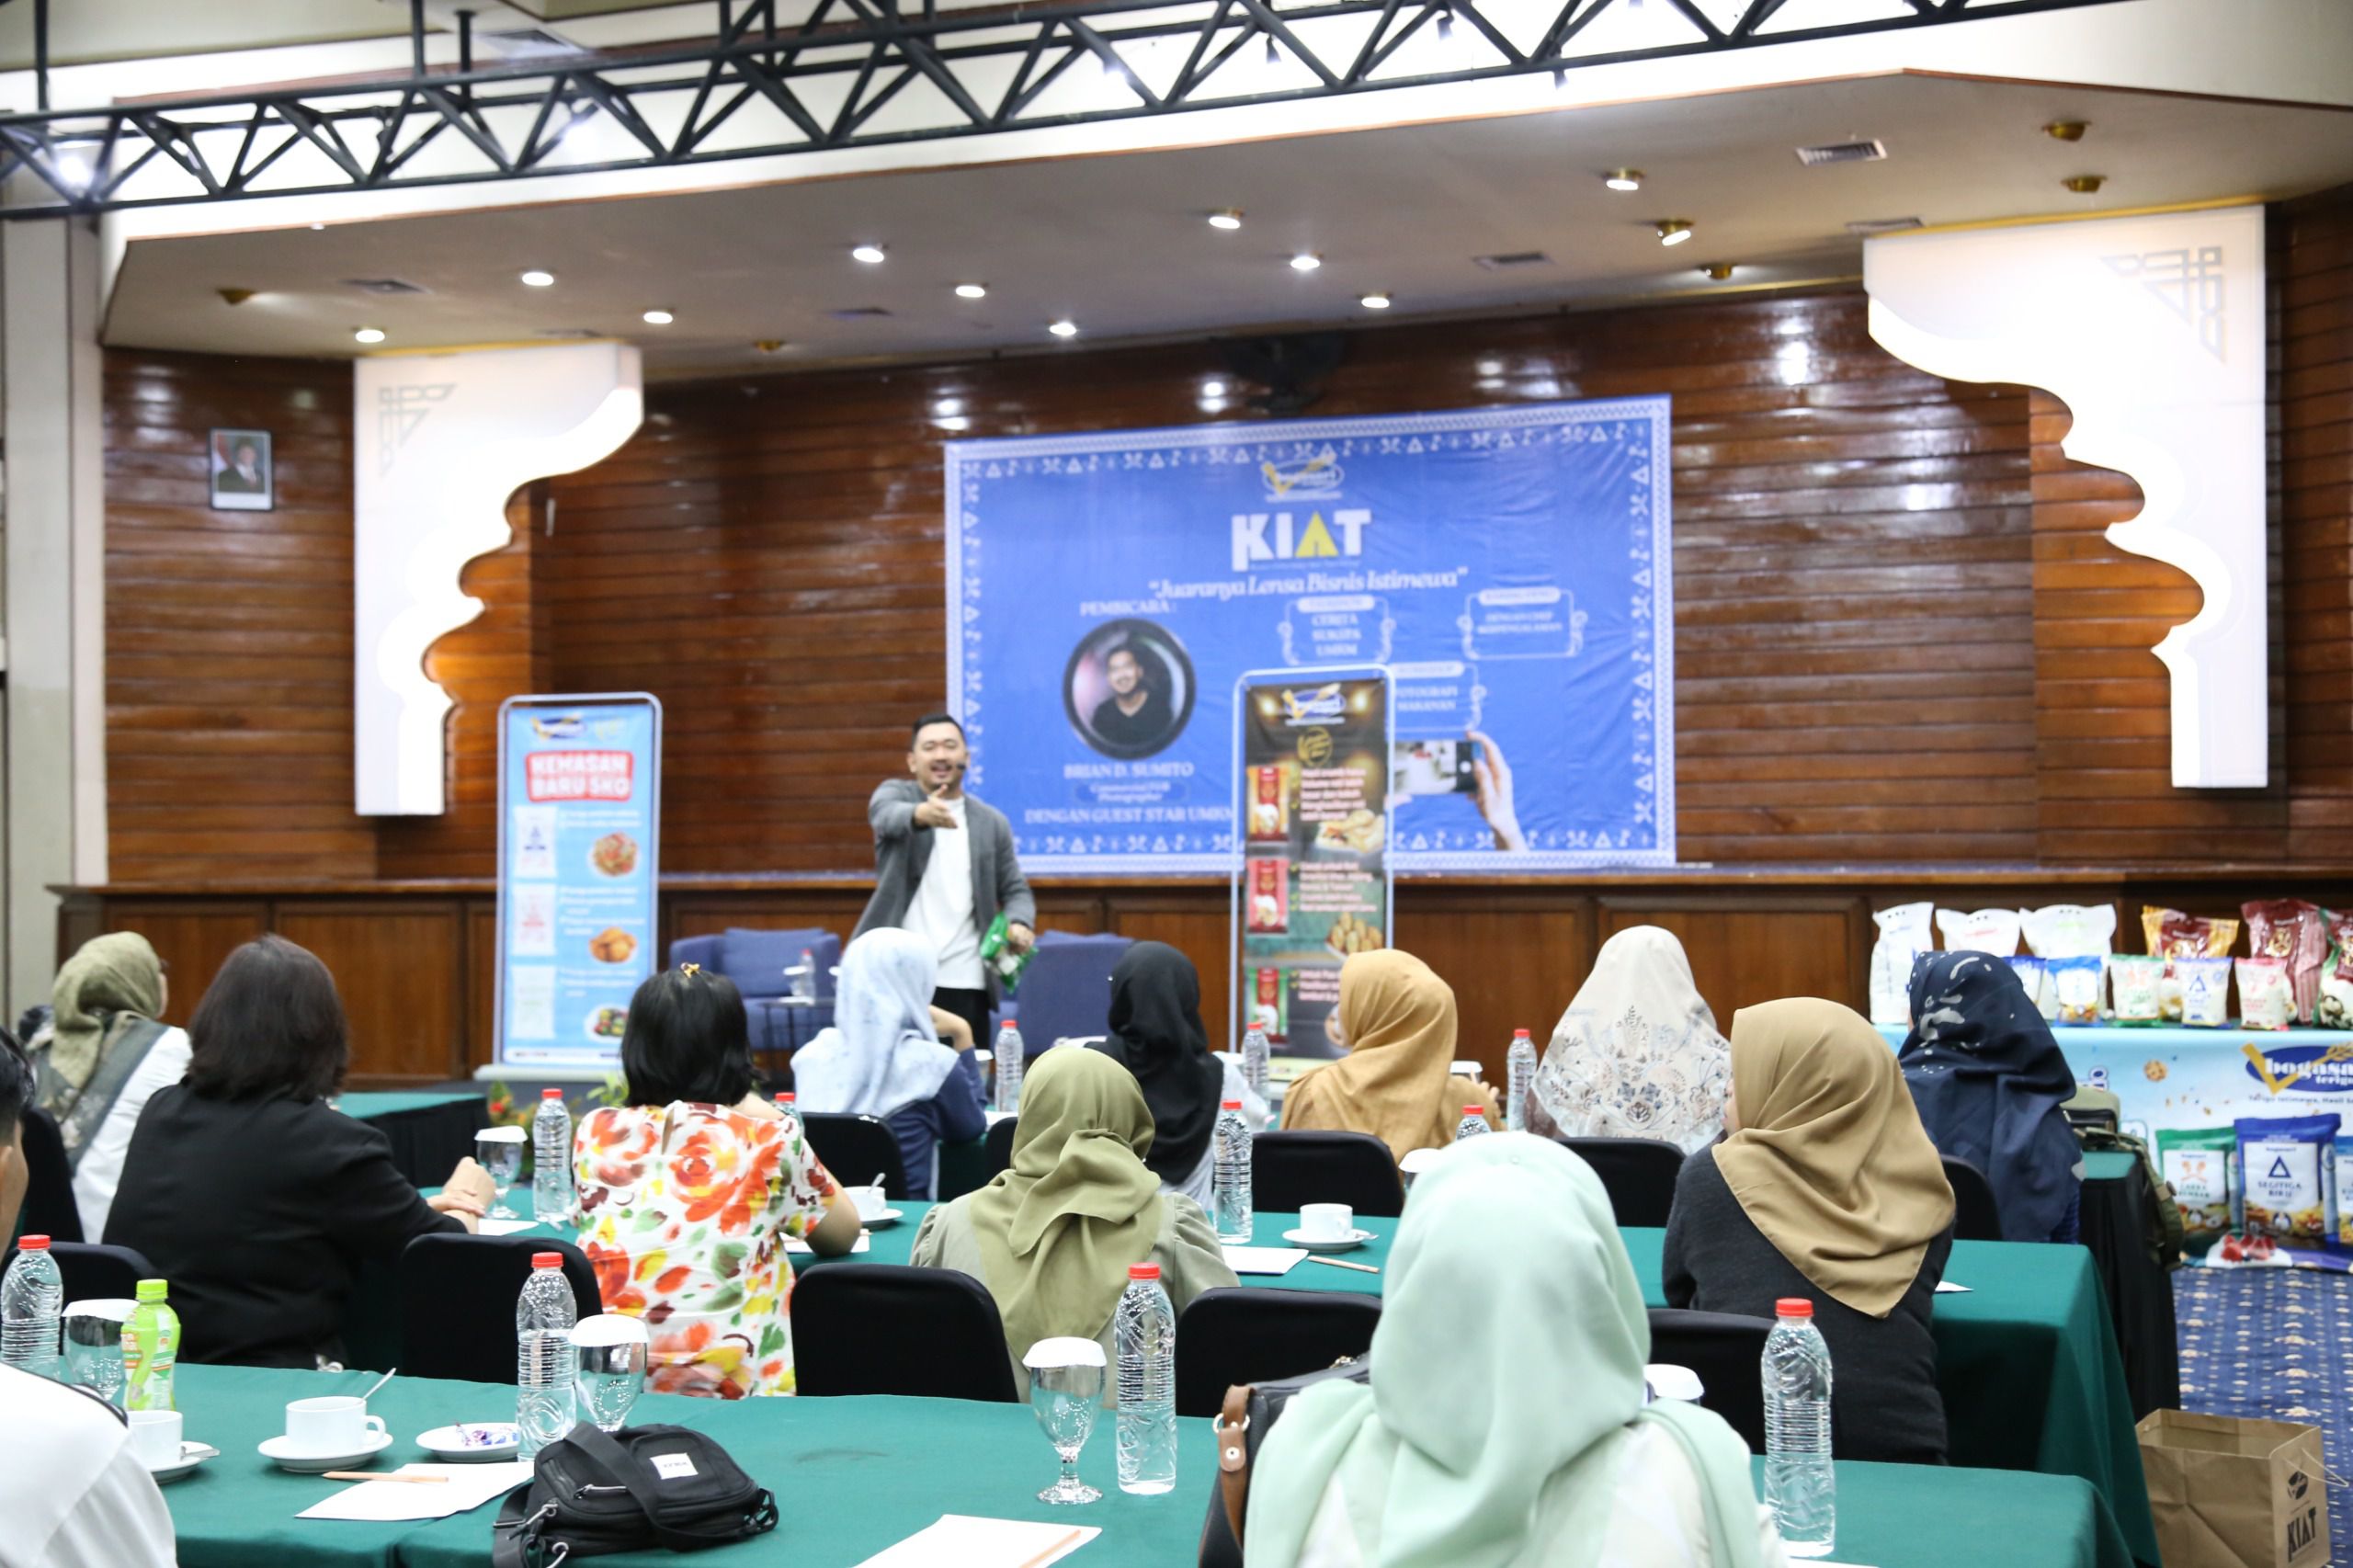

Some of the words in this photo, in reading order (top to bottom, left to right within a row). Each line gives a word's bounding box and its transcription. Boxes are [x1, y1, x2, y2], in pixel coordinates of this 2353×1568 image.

[1232, 509, 1372, 572] KIAT
[1307, 572, 1366, 593] Bisnis
[532, 777, 586, 796] BARU
[2286, 1506, 2317, 1563] KIAT
